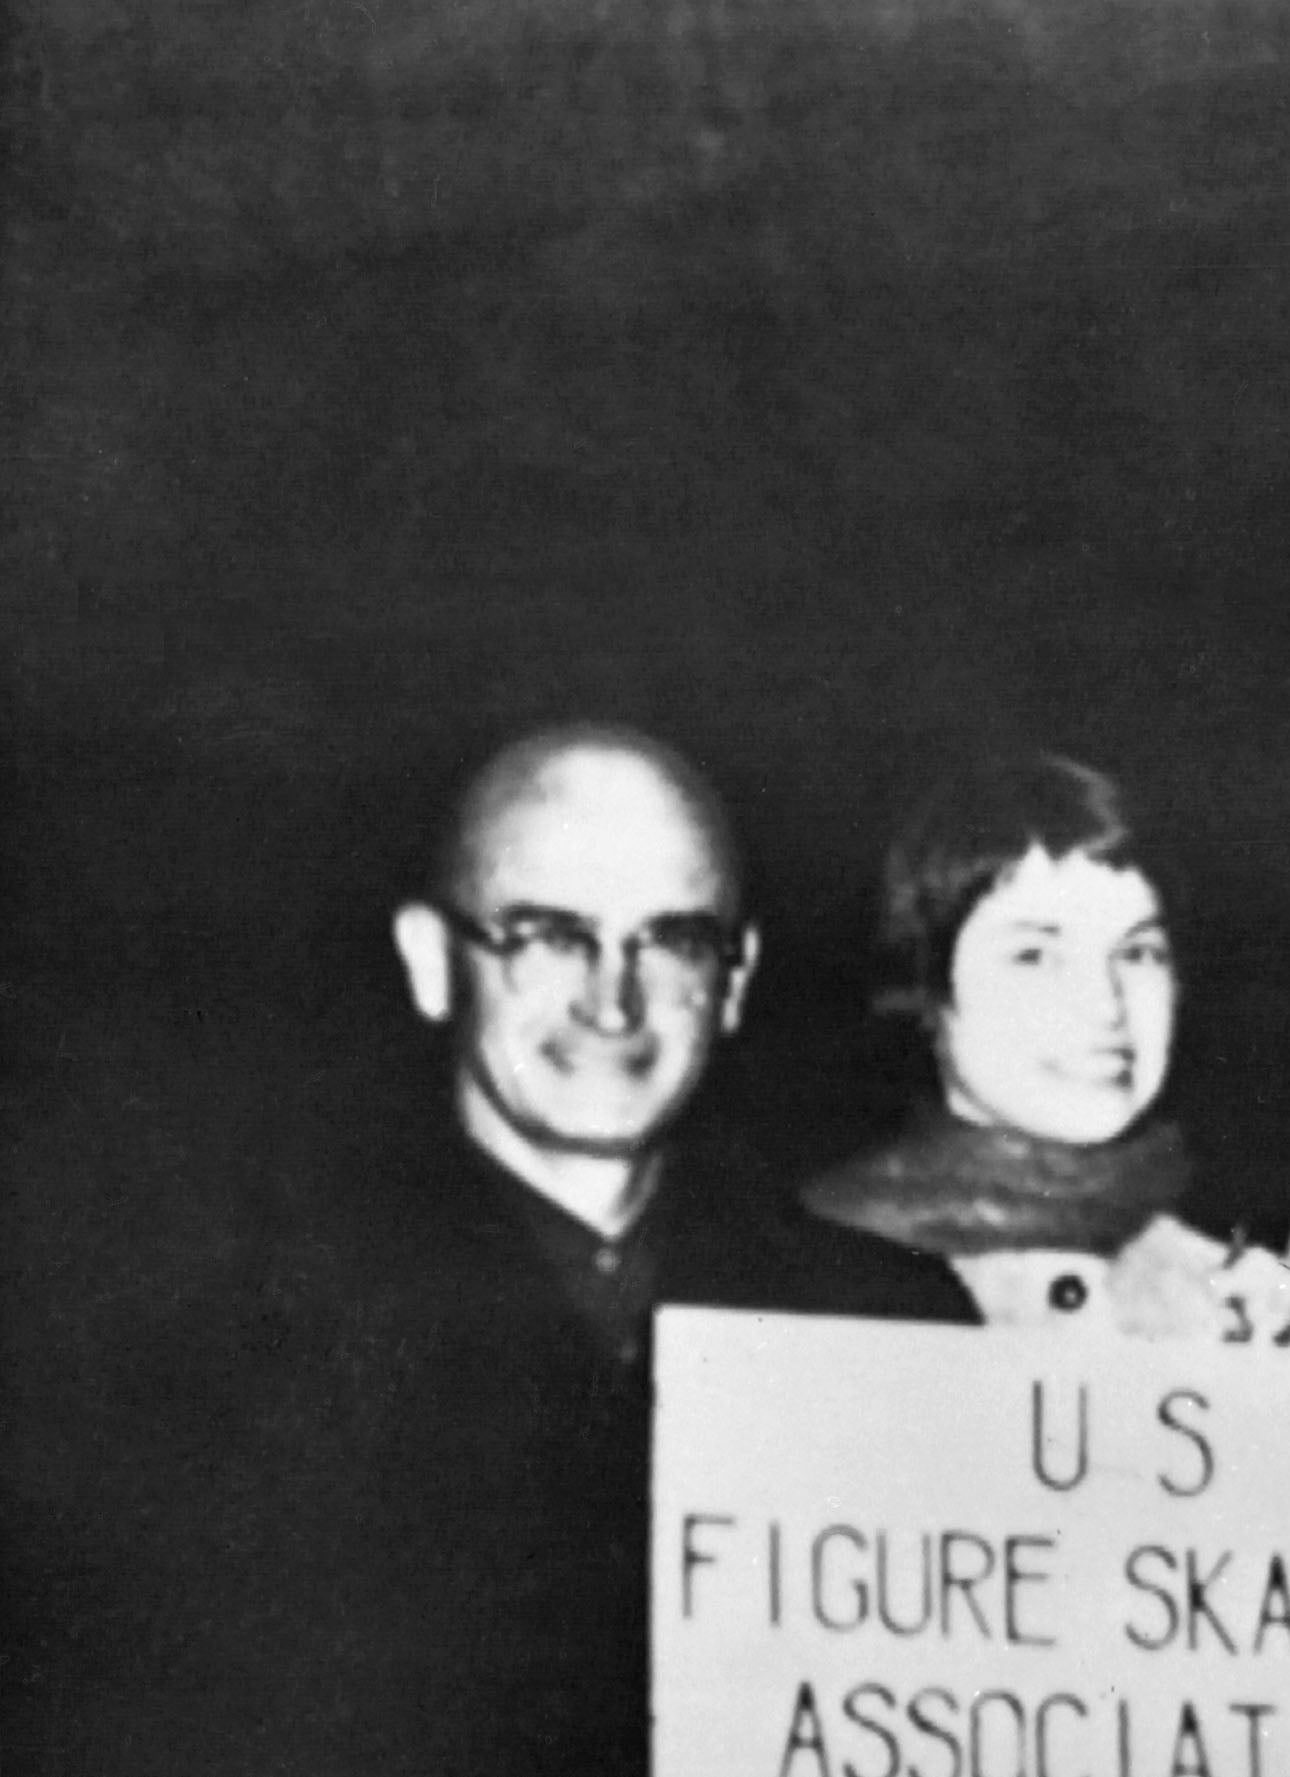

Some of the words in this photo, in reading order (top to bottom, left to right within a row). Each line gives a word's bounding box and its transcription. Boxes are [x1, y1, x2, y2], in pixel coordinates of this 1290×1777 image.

[1029, 1378, 1092, 1495] U
[1154, 1387, 1217, 1500] S
[679, 1511, 1060, 1649] FIGURE
